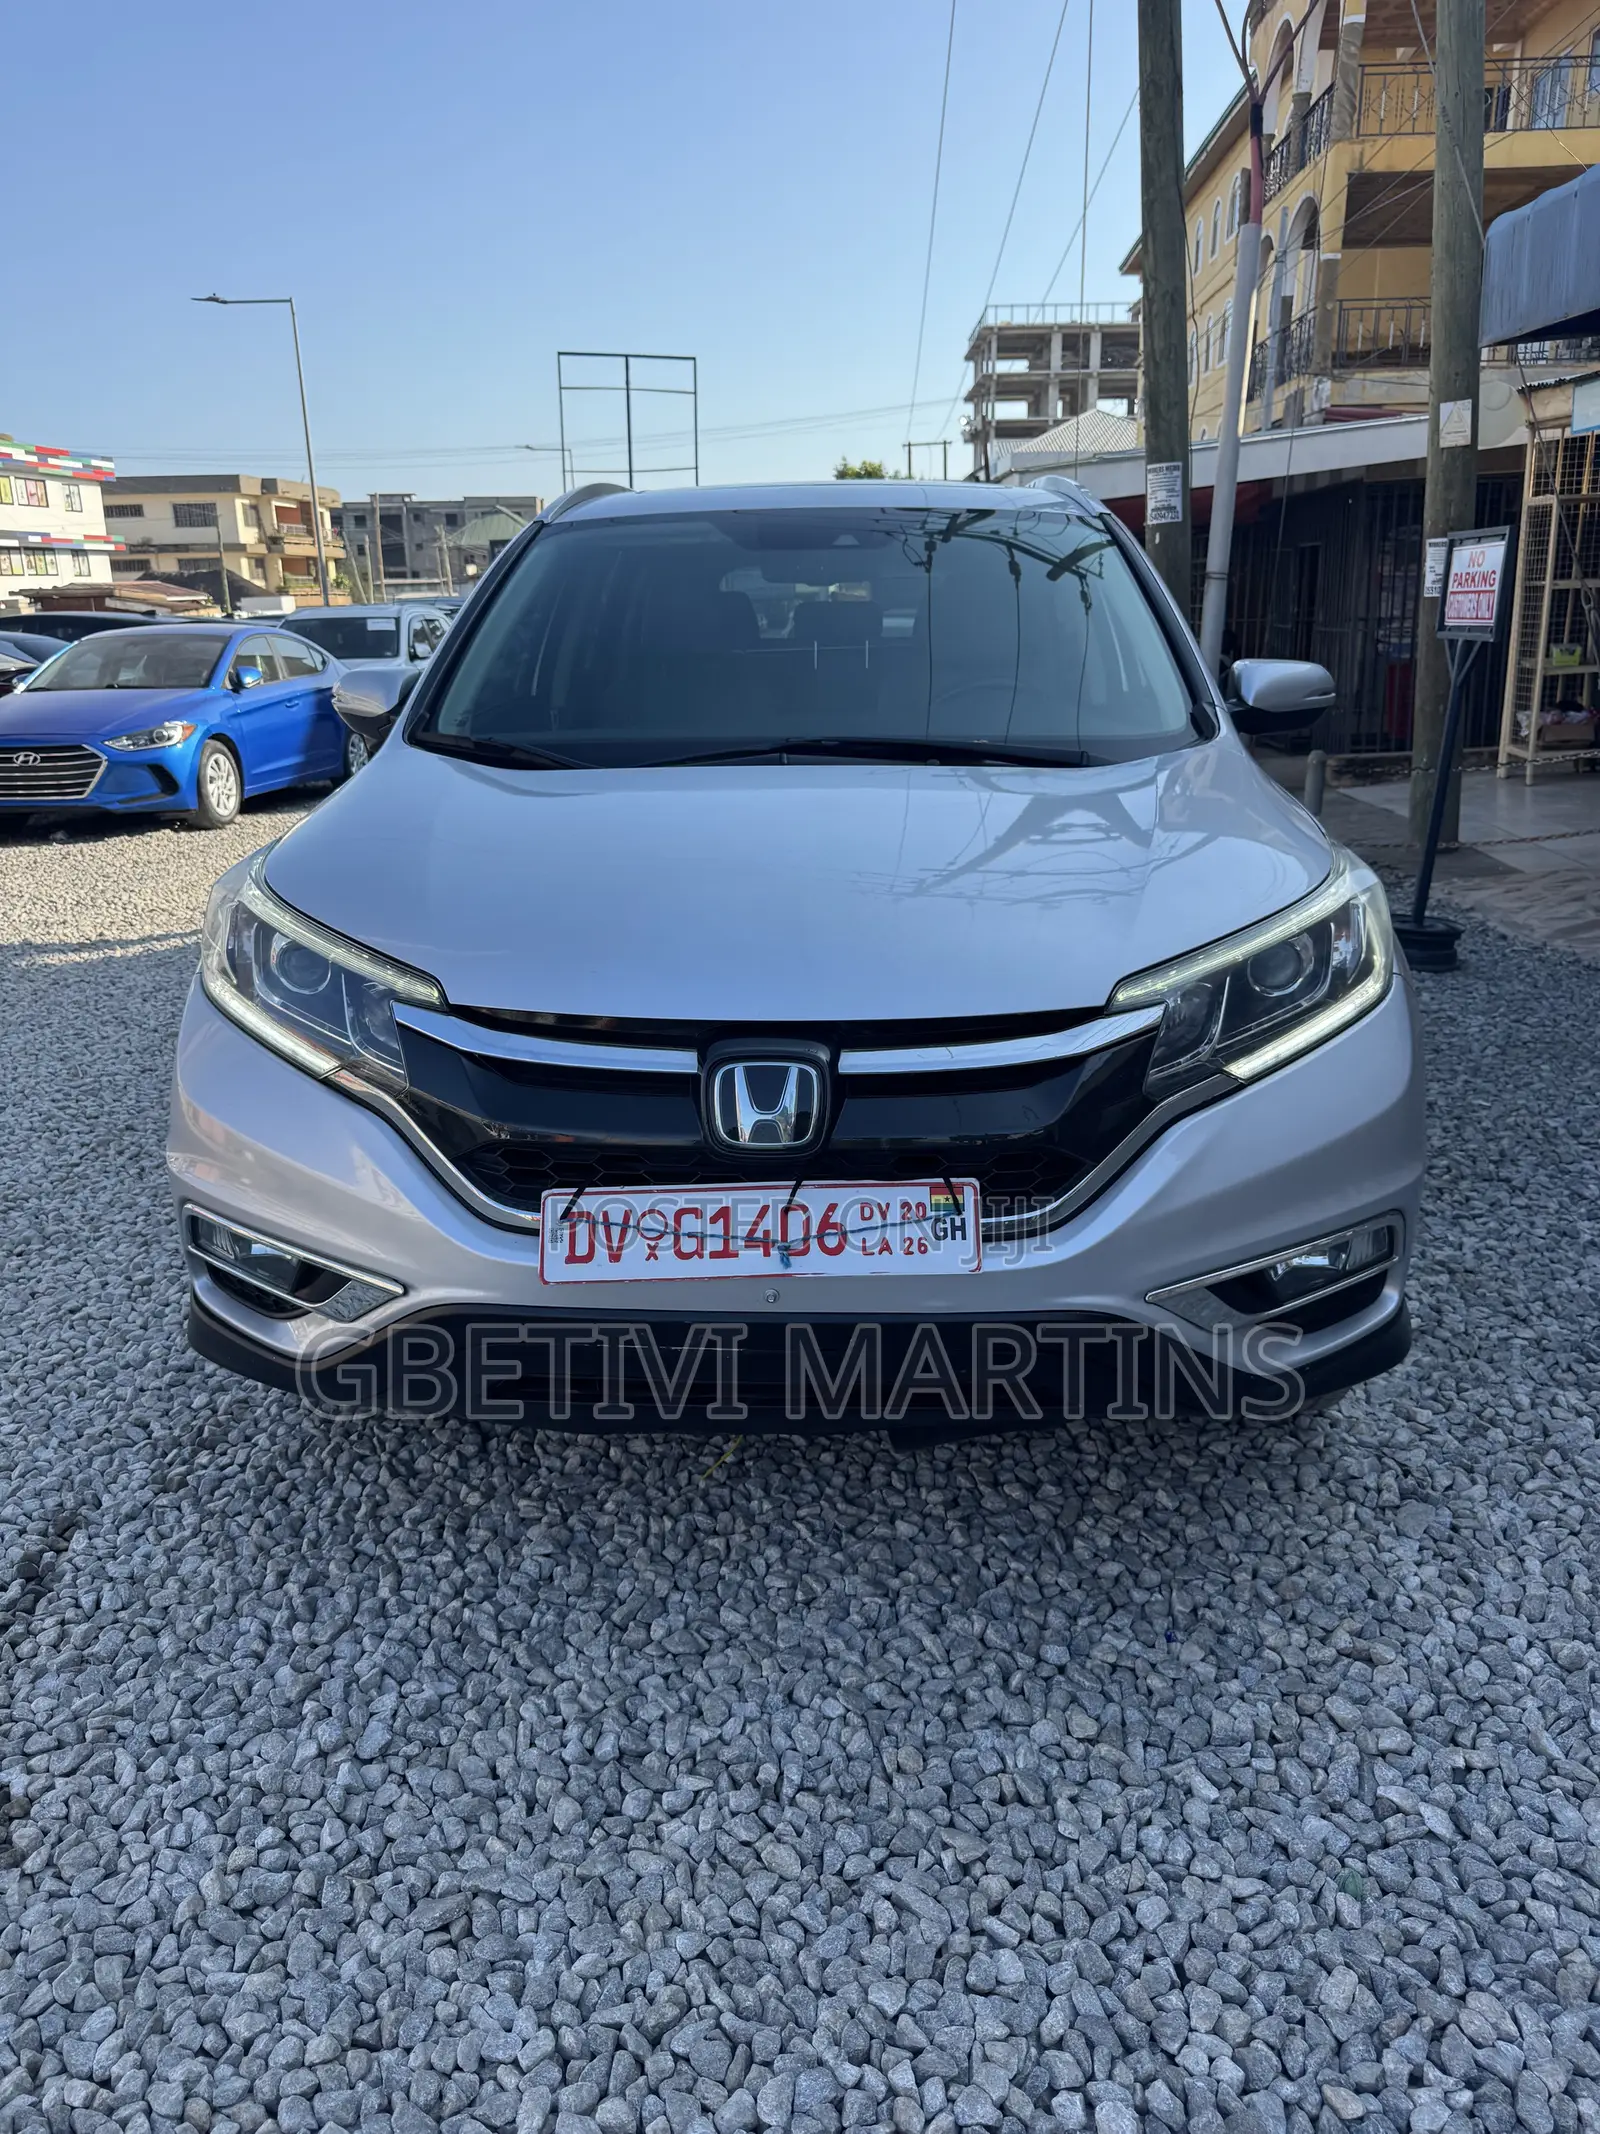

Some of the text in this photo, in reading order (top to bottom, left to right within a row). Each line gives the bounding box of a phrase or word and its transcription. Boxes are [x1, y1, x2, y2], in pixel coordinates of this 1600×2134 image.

[1468, 551, 1486, 568] NO
[1452, 570, 1496, 588] PARKING
[860, 1202, 927, 1221] DV 20
[930, 1217, 967, 1241] GH
[861, 1236, 928, 1255] LA 26
